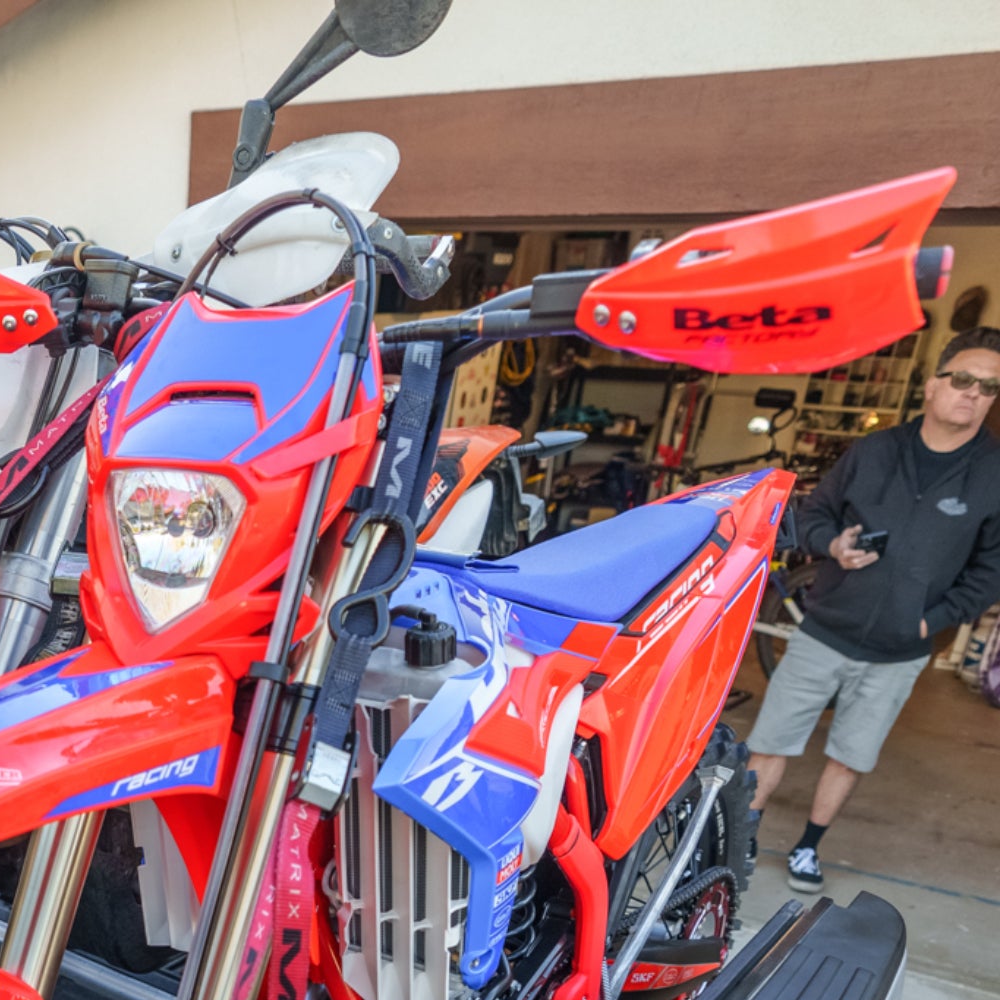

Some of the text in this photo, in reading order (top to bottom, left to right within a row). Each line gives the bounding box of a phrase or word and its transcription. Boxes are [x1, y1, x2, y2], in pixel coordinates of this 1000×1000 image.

[673, 304, 831, 331] Beta
[424, 478, 448, 510] EXC
[110, 754, 199, 797] racing
[289, 803, 309, 919] MATRIX
[631, 972, 655, 983] SKF
